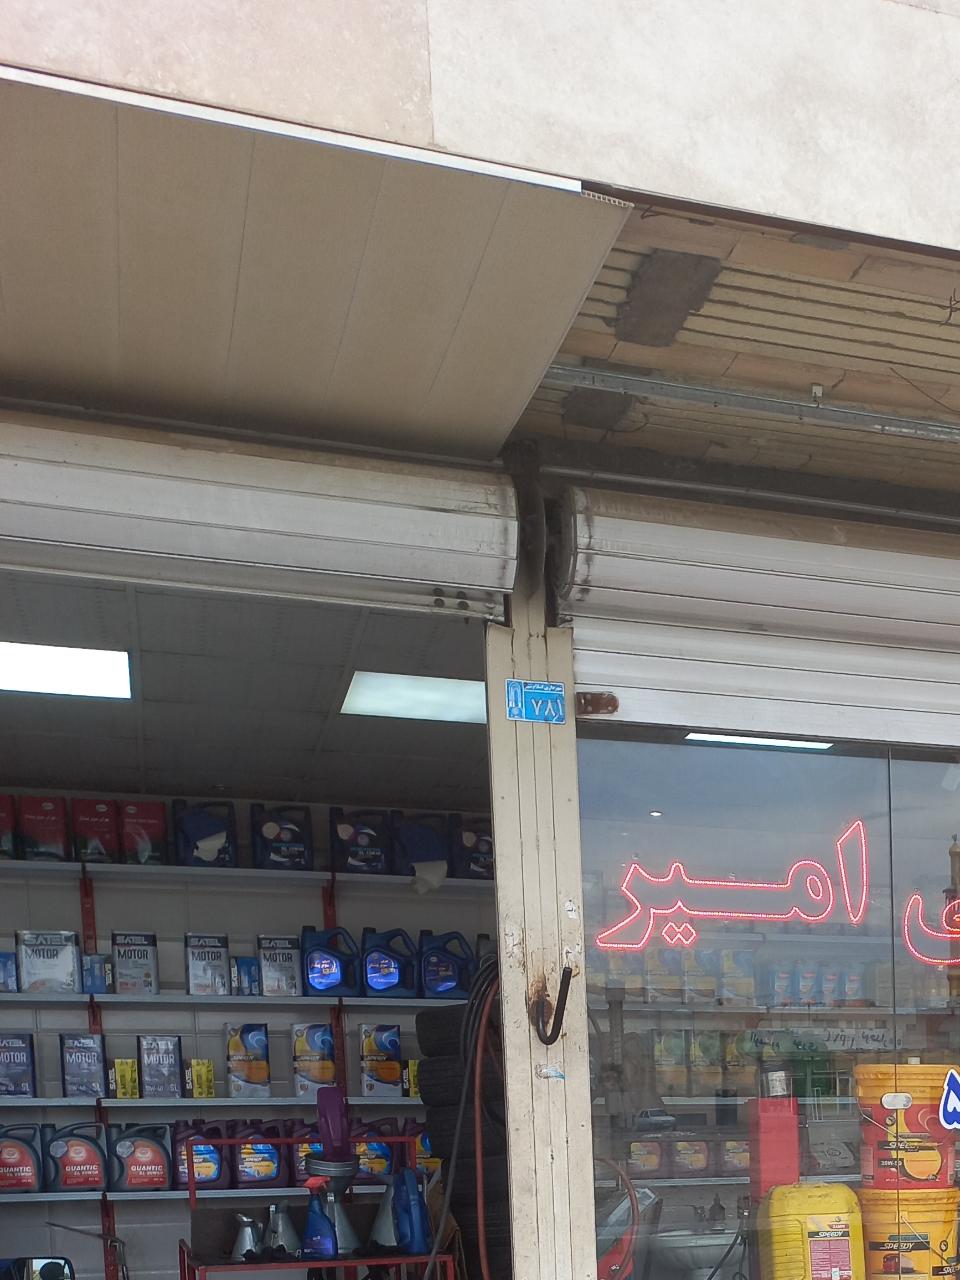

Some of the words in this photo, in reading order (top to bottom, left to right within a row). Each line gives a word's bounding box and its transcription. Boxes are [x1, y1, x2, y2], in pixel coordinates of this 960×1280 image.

[596, 819, 867, 948] امیر
[24, 948, 59, 960] MOTOR
[117, 949, 149, 960] MOTOR
[191, 951, 222, 961] MOTOR
[263, 952, 293, 963] MOTOR
[66, 1052, 98, 1063] MOTOR
[144, 1054, 175, 1065] MOTOR
[65, 1164, 98, 1172] QUANTIC
[131, 1164, 163, 1172] QUANTIC
[880, 1242, 914, 1250] SPEEDY
